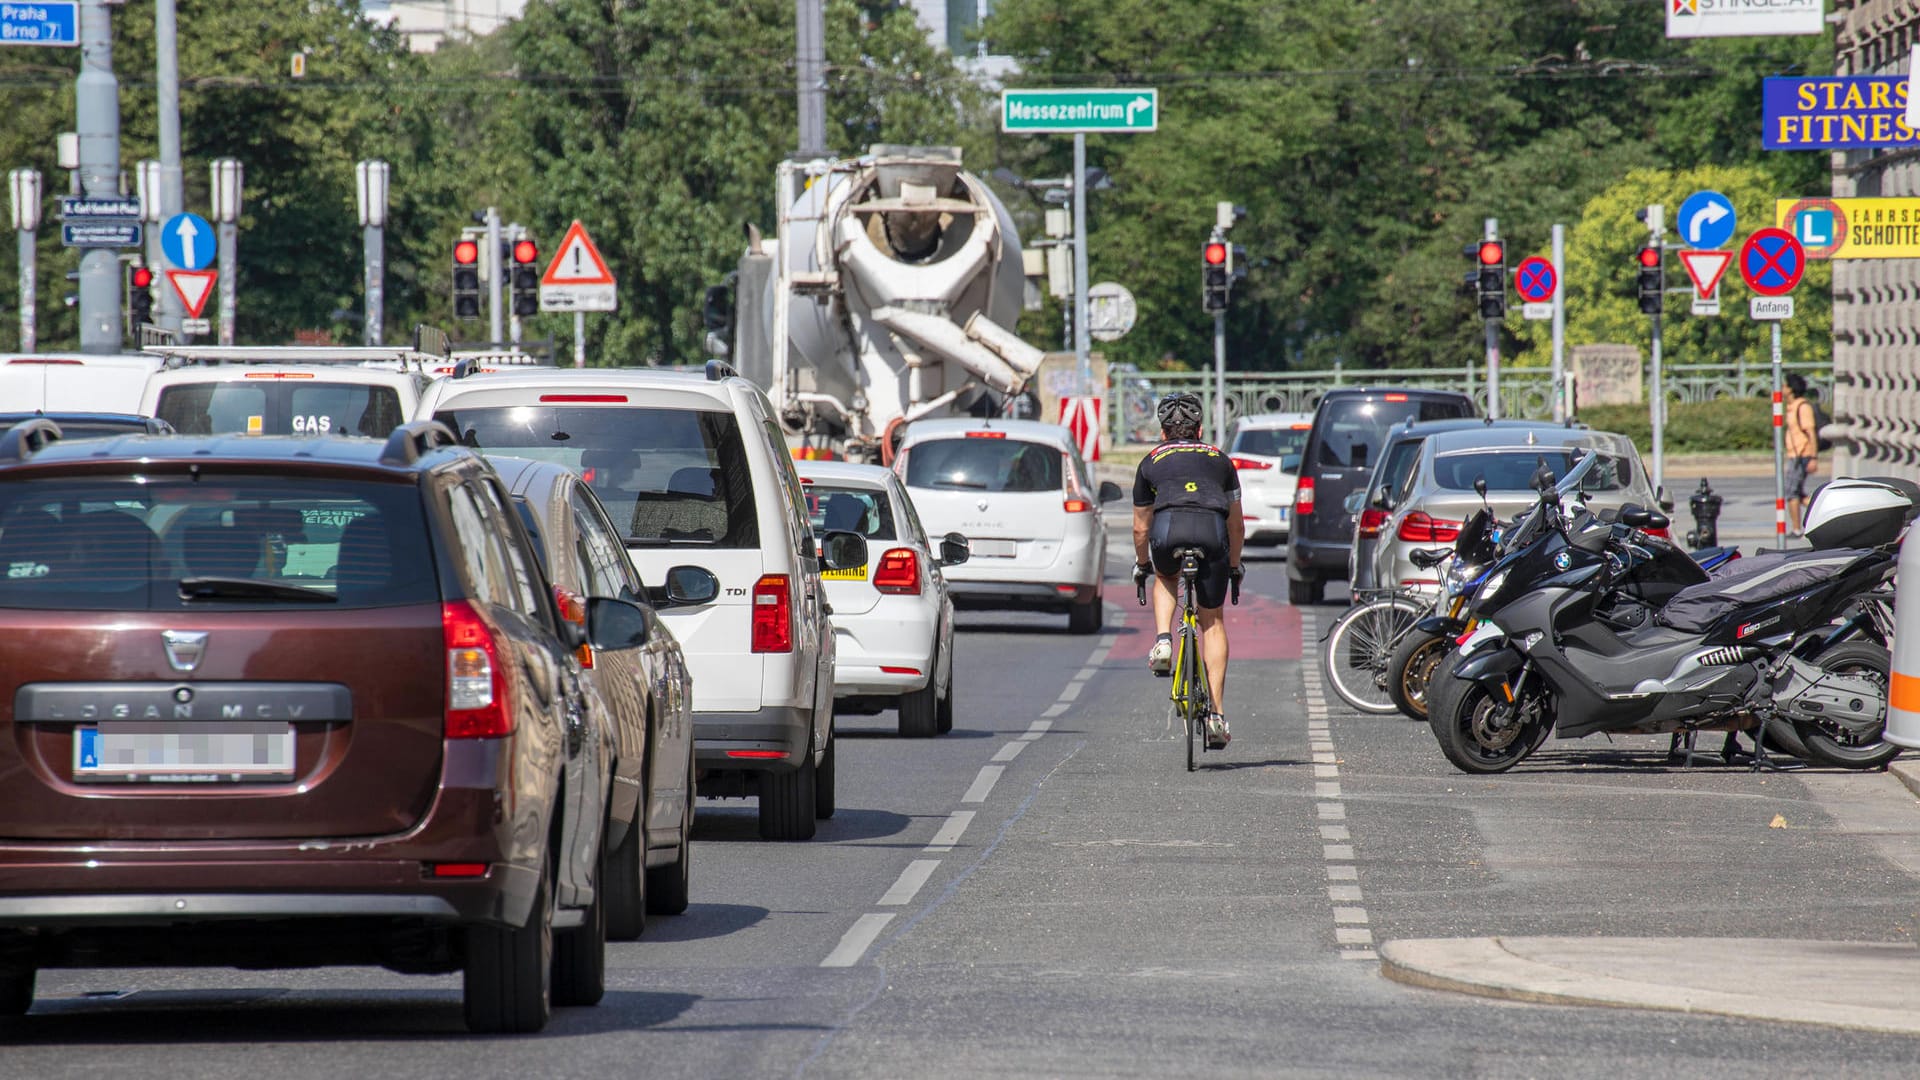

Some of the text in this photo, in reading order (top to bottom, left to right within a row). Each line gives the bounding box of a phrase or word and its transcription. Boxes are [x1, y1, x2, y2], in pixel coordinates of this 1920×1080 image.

[2, 5, 48, 20] Praha
[2, 23, 58, 39] Brno 7
[1797, 81, 1909, 111] STARS
[1009, 100, 1125, 120] Messezentrum
[1776, 113, 1920, 143] FITNES
[1853, 209, 1920, 222] FAHRSC
[1853, 225, 1920, 245] SCHOTTE
[1756, 301, 1790, 315] Anfang
[292, 415, 331, 433] GAS
[725, 588, 747, 596] TDI
[50, 703, 193, 719] LOGAN
